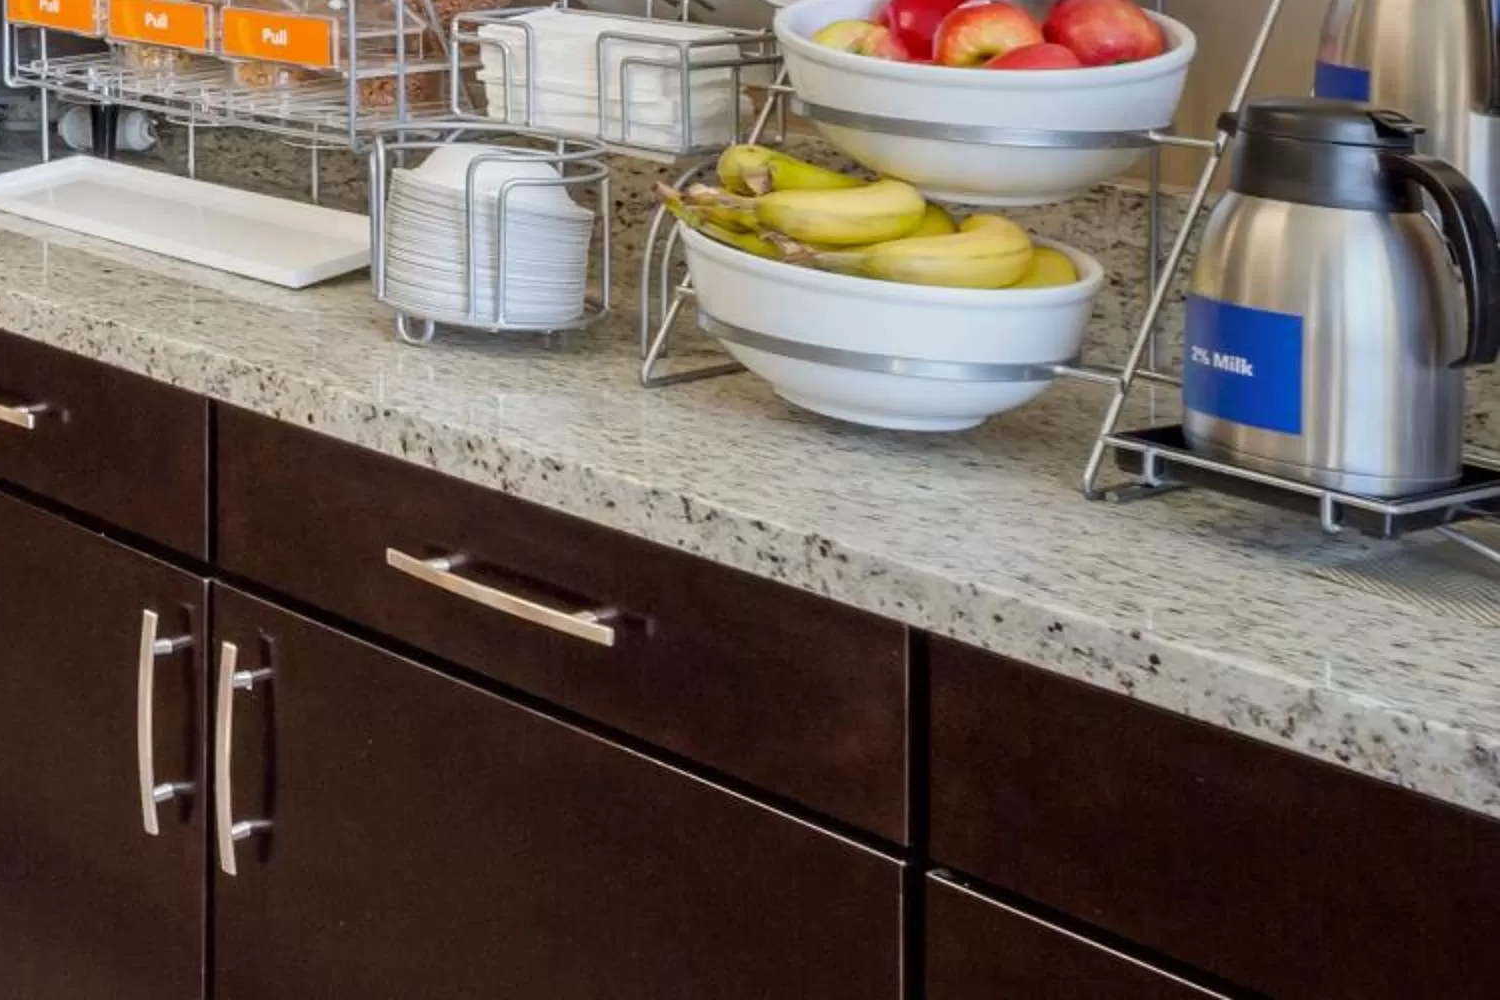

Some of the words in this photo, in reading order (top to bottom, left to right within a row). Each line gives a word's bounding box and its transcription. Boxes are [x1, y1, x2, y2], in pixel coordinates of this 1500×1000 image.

[144, 12, 168, 30] Pull
[262, 27, 288, 47] Pull
[1191, 345, 1211, 366] 2%
[1213, 352, 1254, 377] Milk
